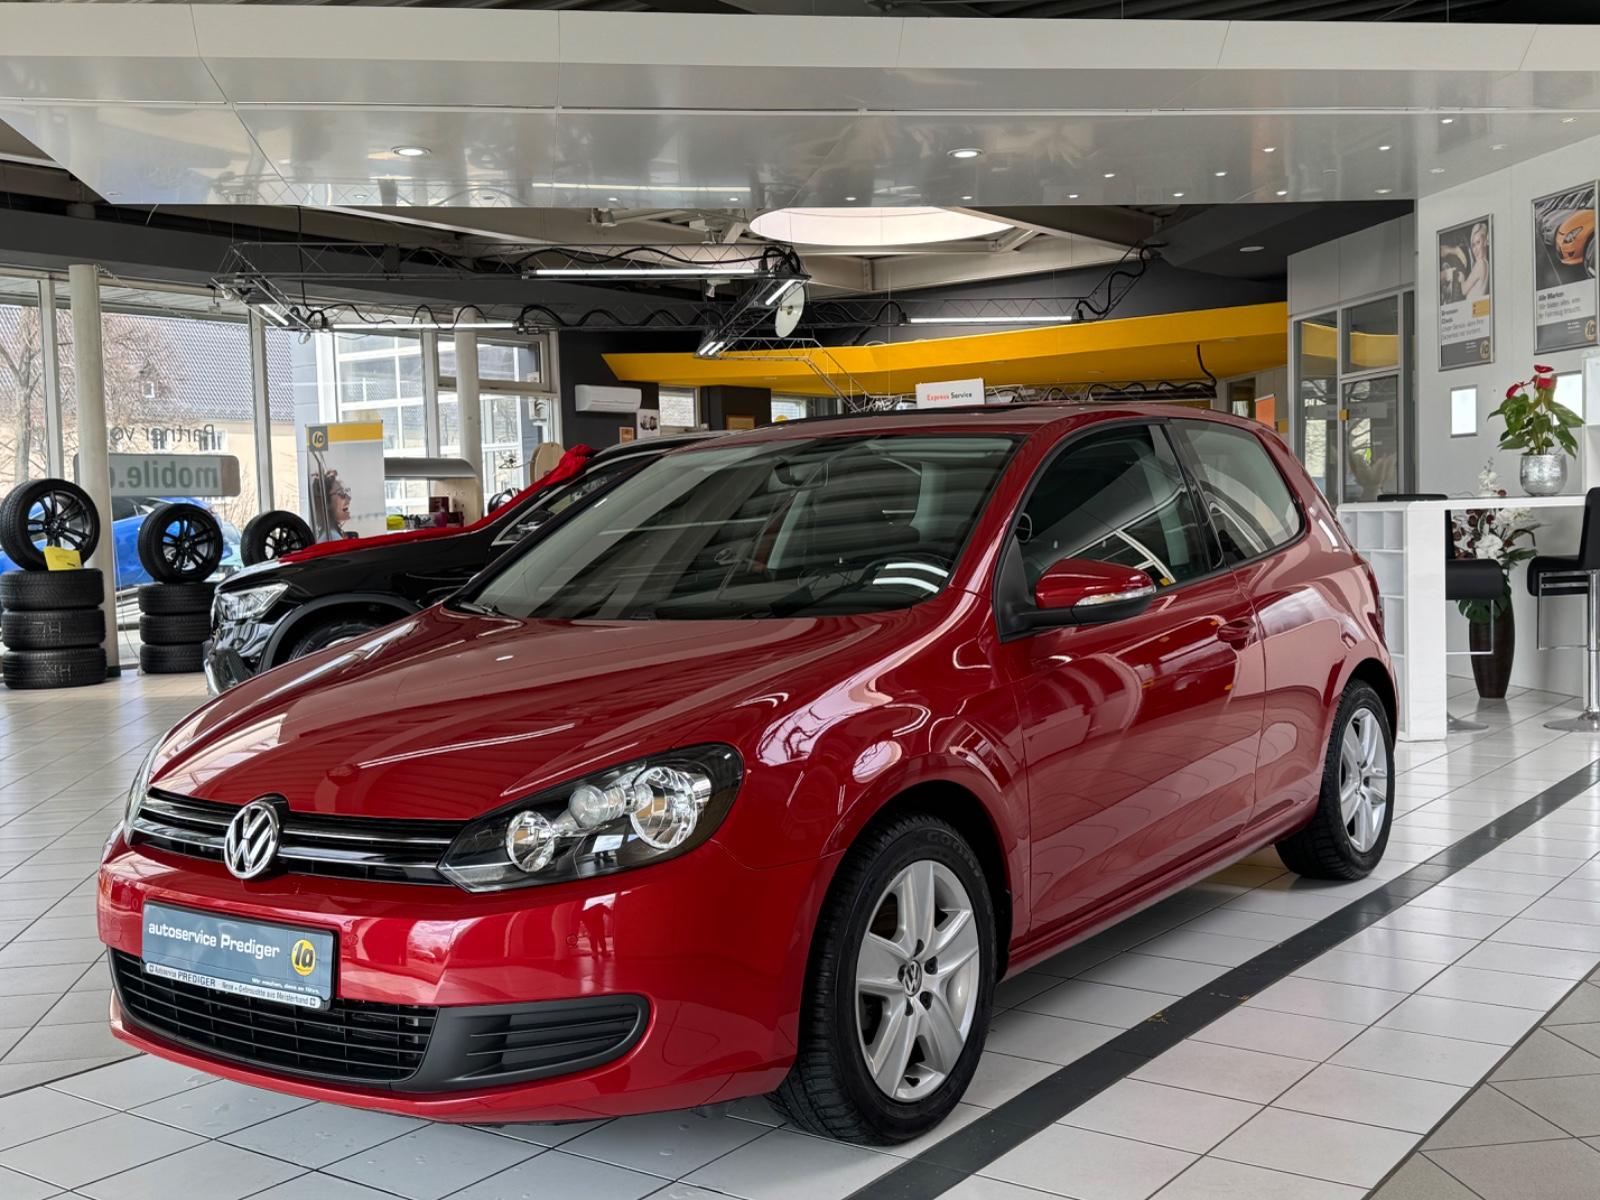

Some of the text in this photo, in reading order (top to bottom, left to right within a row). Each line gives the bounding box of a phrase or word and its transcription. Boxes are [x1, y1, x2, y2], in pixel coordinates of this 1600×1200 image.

[950, 391, 972, 400] Service
[148, 921, 280, 960] autoservice Prediger
[177, 971, 216, 988] PREDIGER
